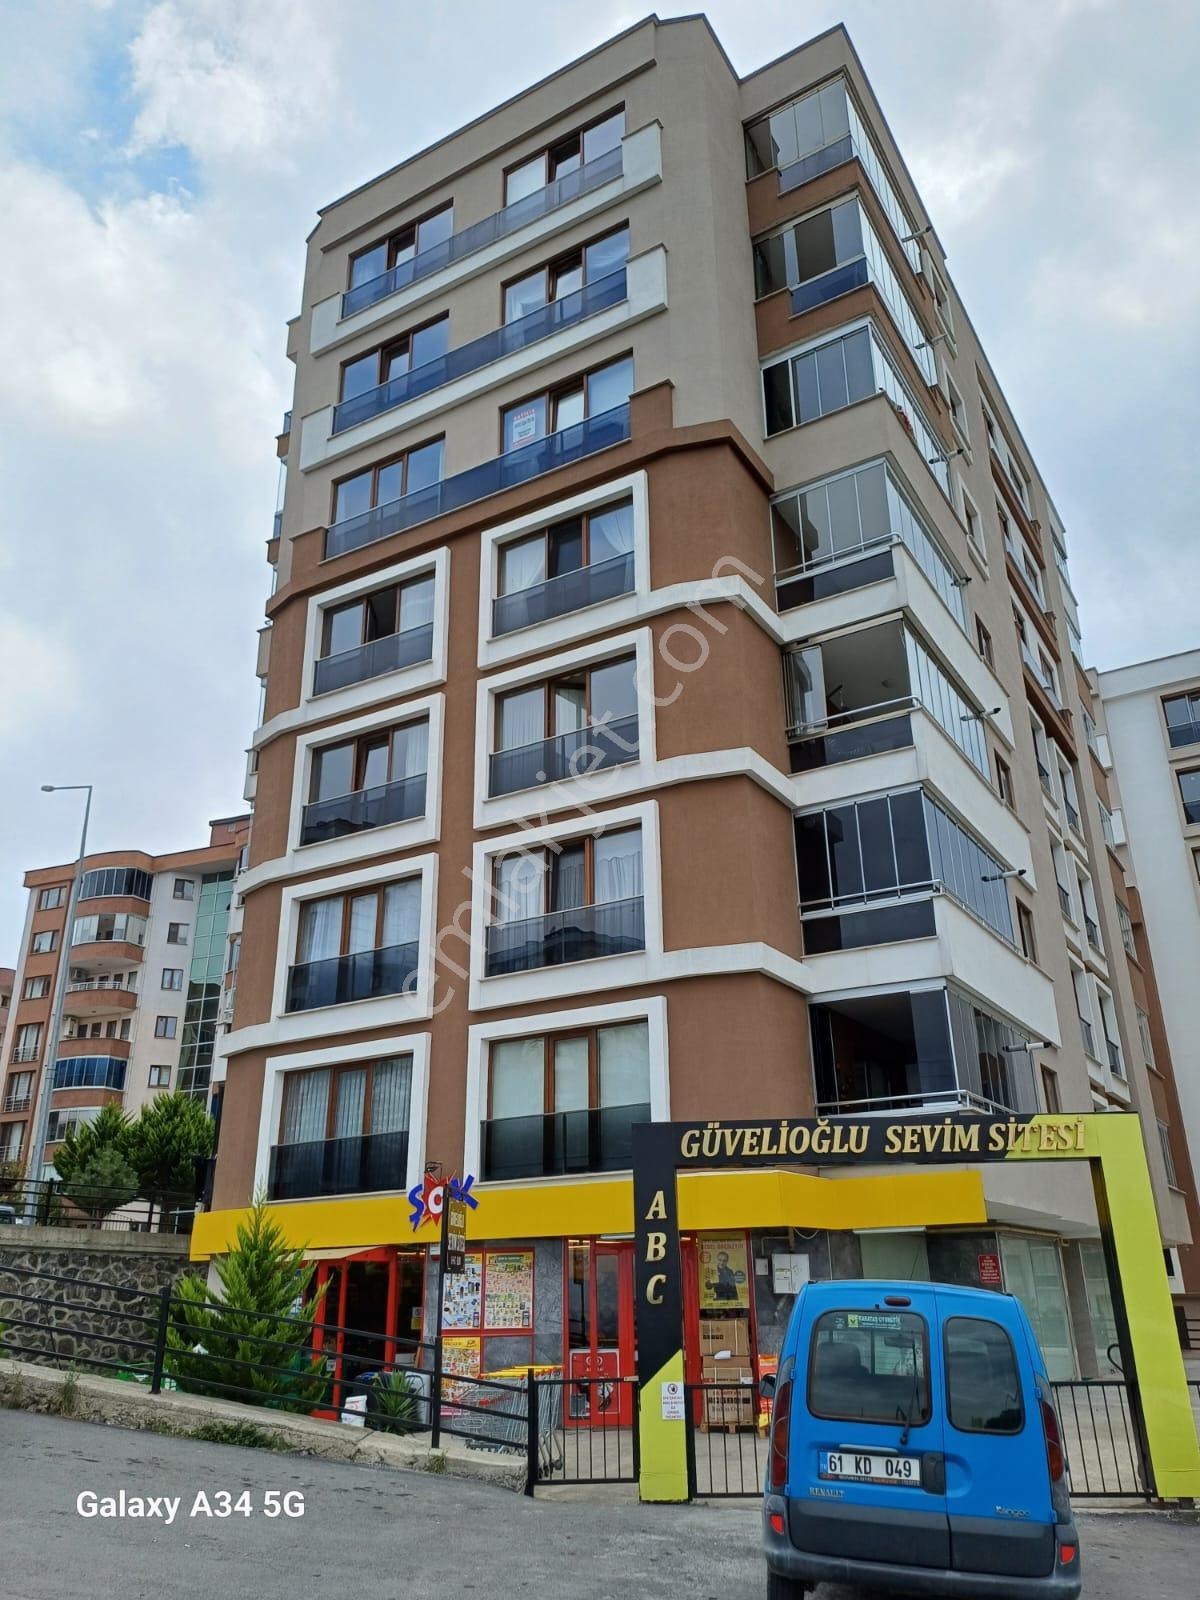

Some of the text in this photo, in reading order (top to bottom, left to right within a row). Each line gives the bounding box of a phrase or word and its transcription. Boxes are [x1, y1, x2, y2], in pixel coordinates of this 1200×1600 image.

[680, 1116, 1087, 1158] GÜVELİOĞLU SEVİM SİTESİ
[645, 1190, 668, 1220] A
[645, 1232, 667, 1262] B
[646, 1274, 667, 1305] C
[829, 1455, 843, 1473] 61
[855, 1456, 872, 1475] KD
[885, 1459, 912, 1478] 049
